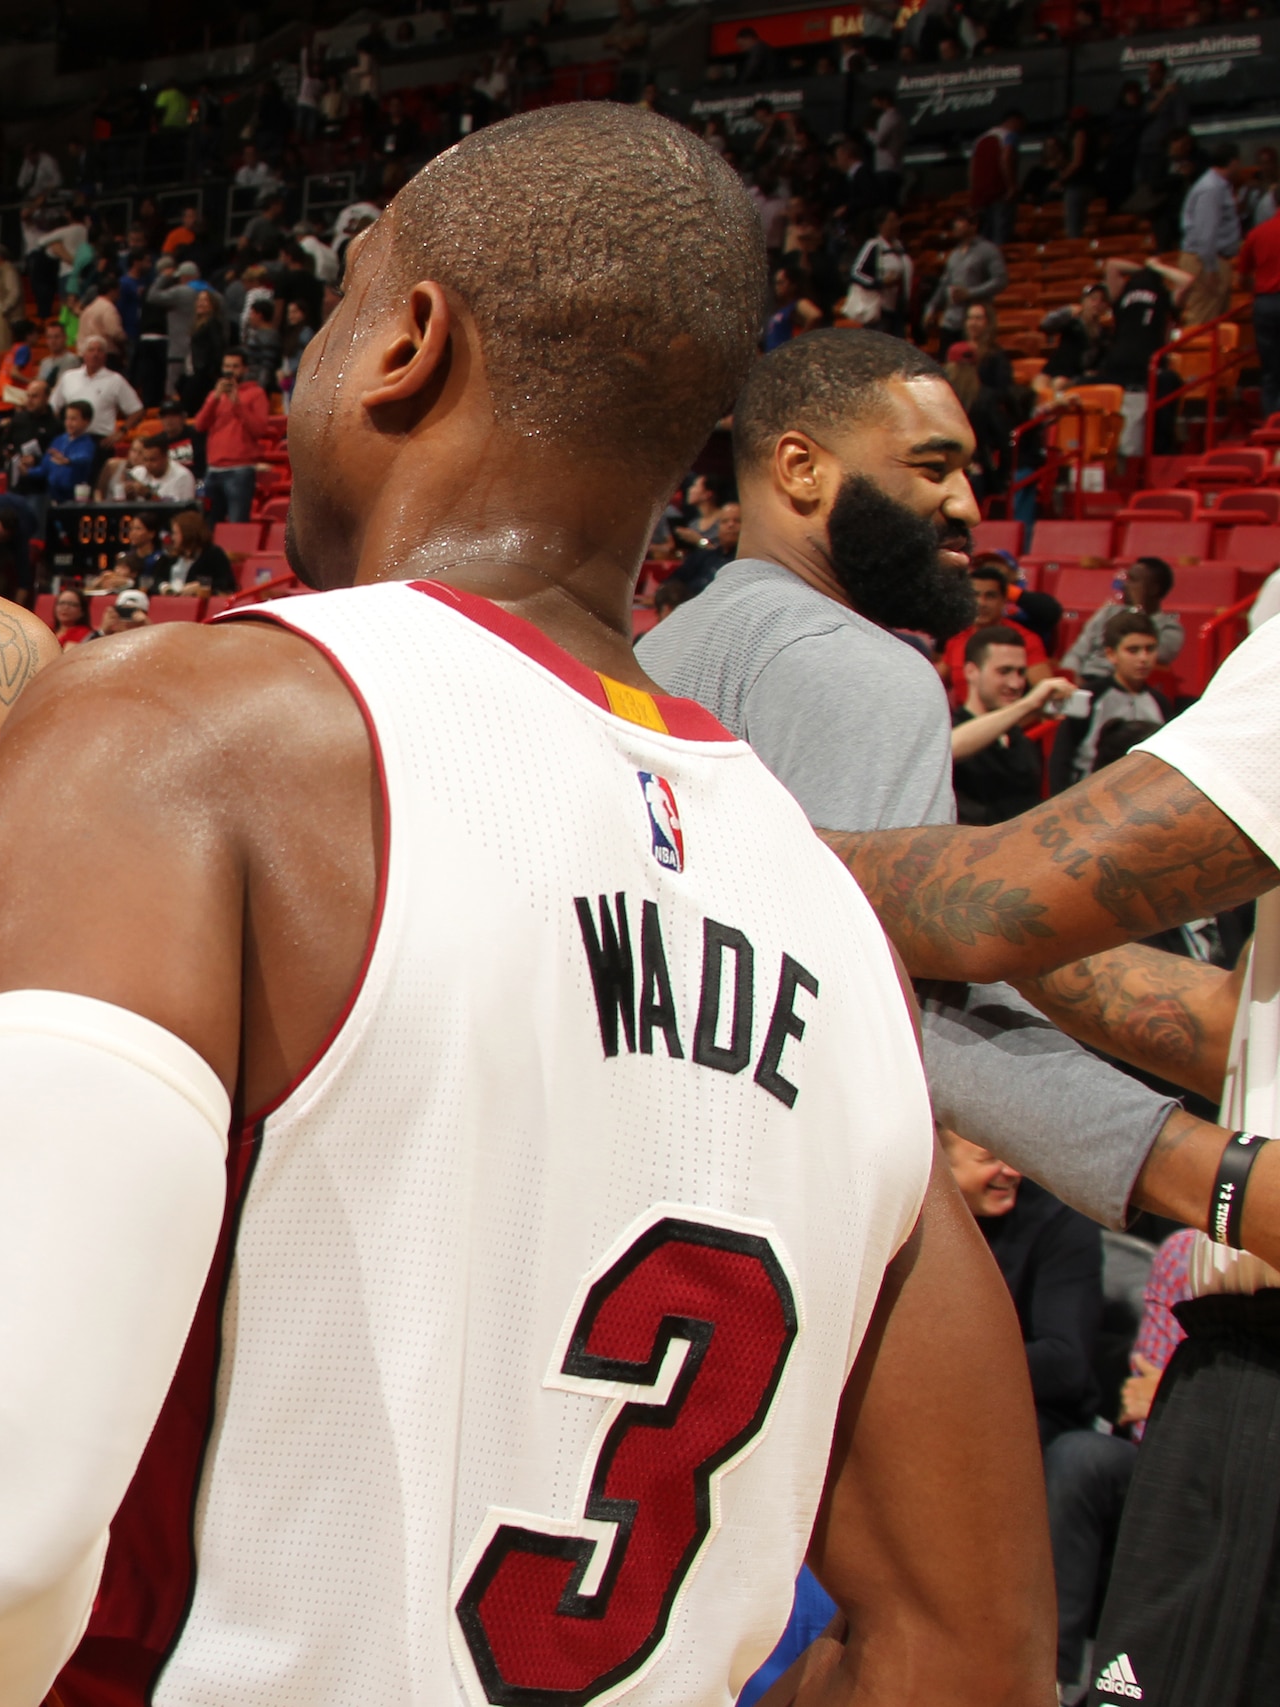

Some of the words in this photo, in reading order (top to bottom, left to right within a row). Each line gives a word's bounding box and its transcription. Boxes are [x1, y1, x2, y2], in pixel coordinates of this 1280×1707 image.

[654, 844, 677, 868] NBA
[573, 891, 819, 1110] WADE
[452, 1205, 803, 1707] 3
[1096, 1677, 1143, 1700] adidas
